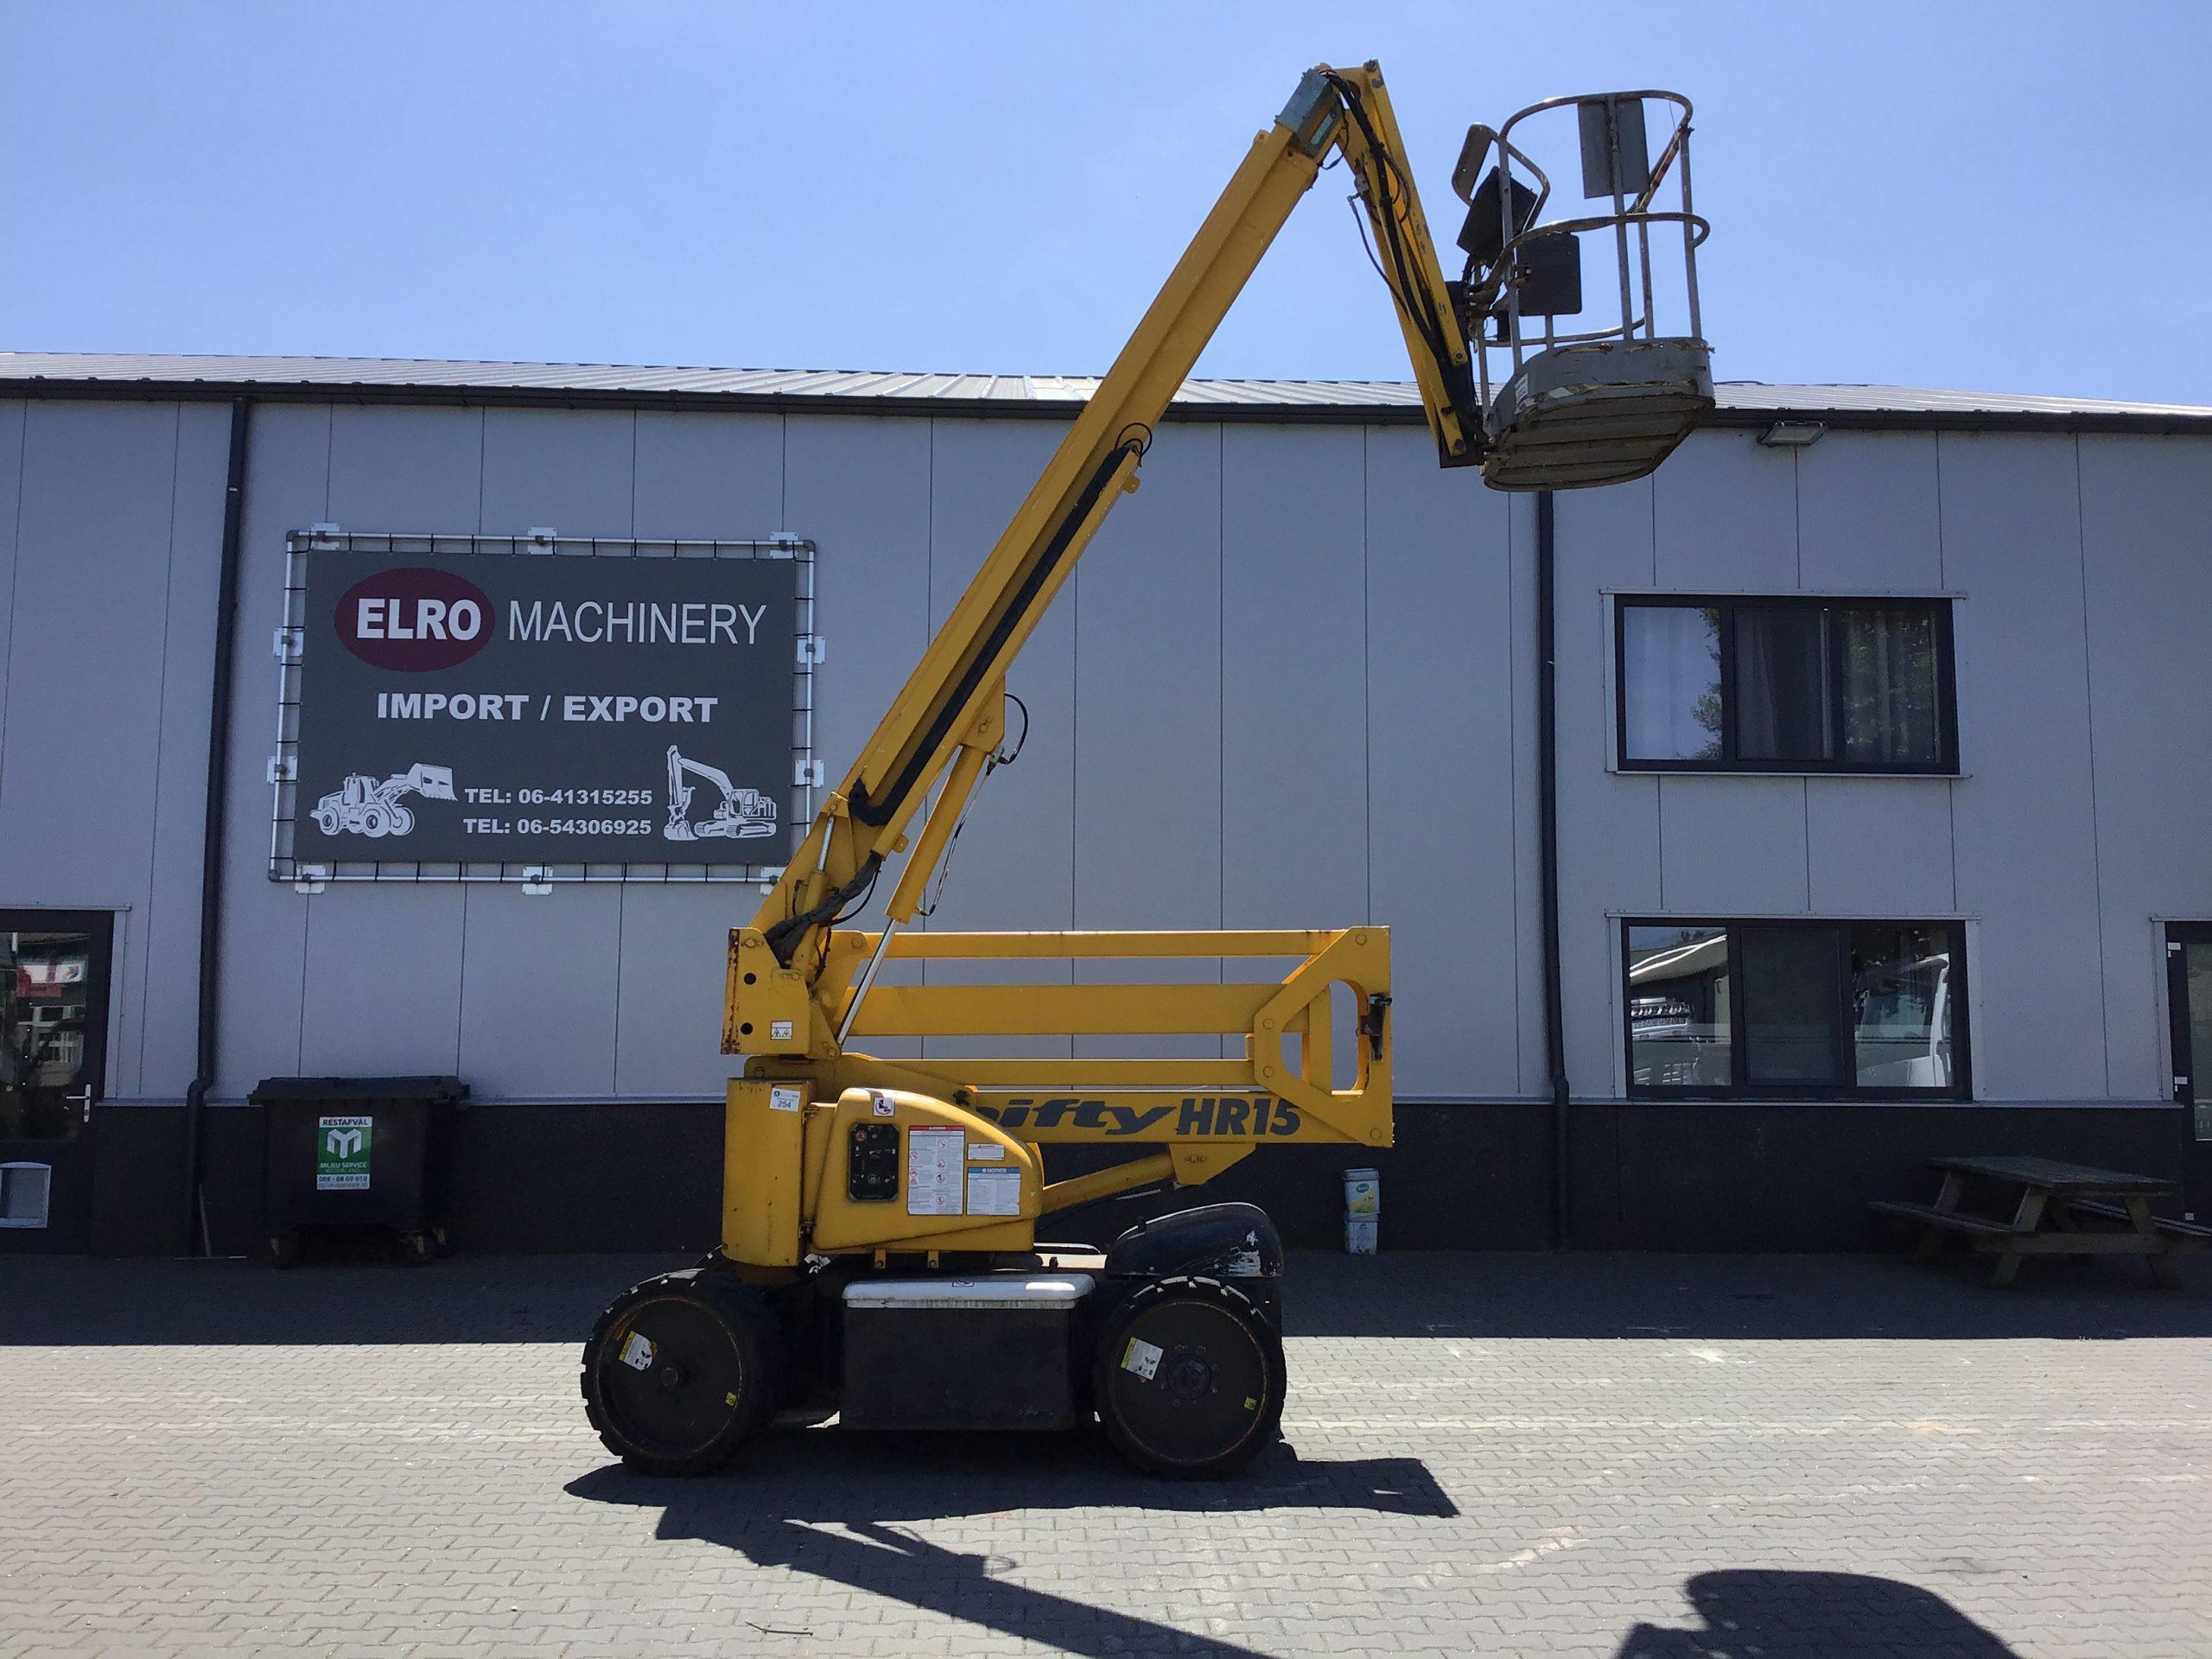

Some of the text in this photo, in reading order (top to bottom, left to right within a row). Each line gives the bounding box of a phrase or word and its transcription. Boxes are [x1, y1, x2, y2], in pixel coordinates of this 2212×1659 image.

[356, 598, 767, 645] ELRO MACHINERY
[377, 692, 719, 723] IMPORT / EXPORT
[464, 788, 653, 805] TEL: 06-41315255
[463, 818, 652, 835] TEL: 06-54306925
[1176, 1097, 1301, 1136] HR15
